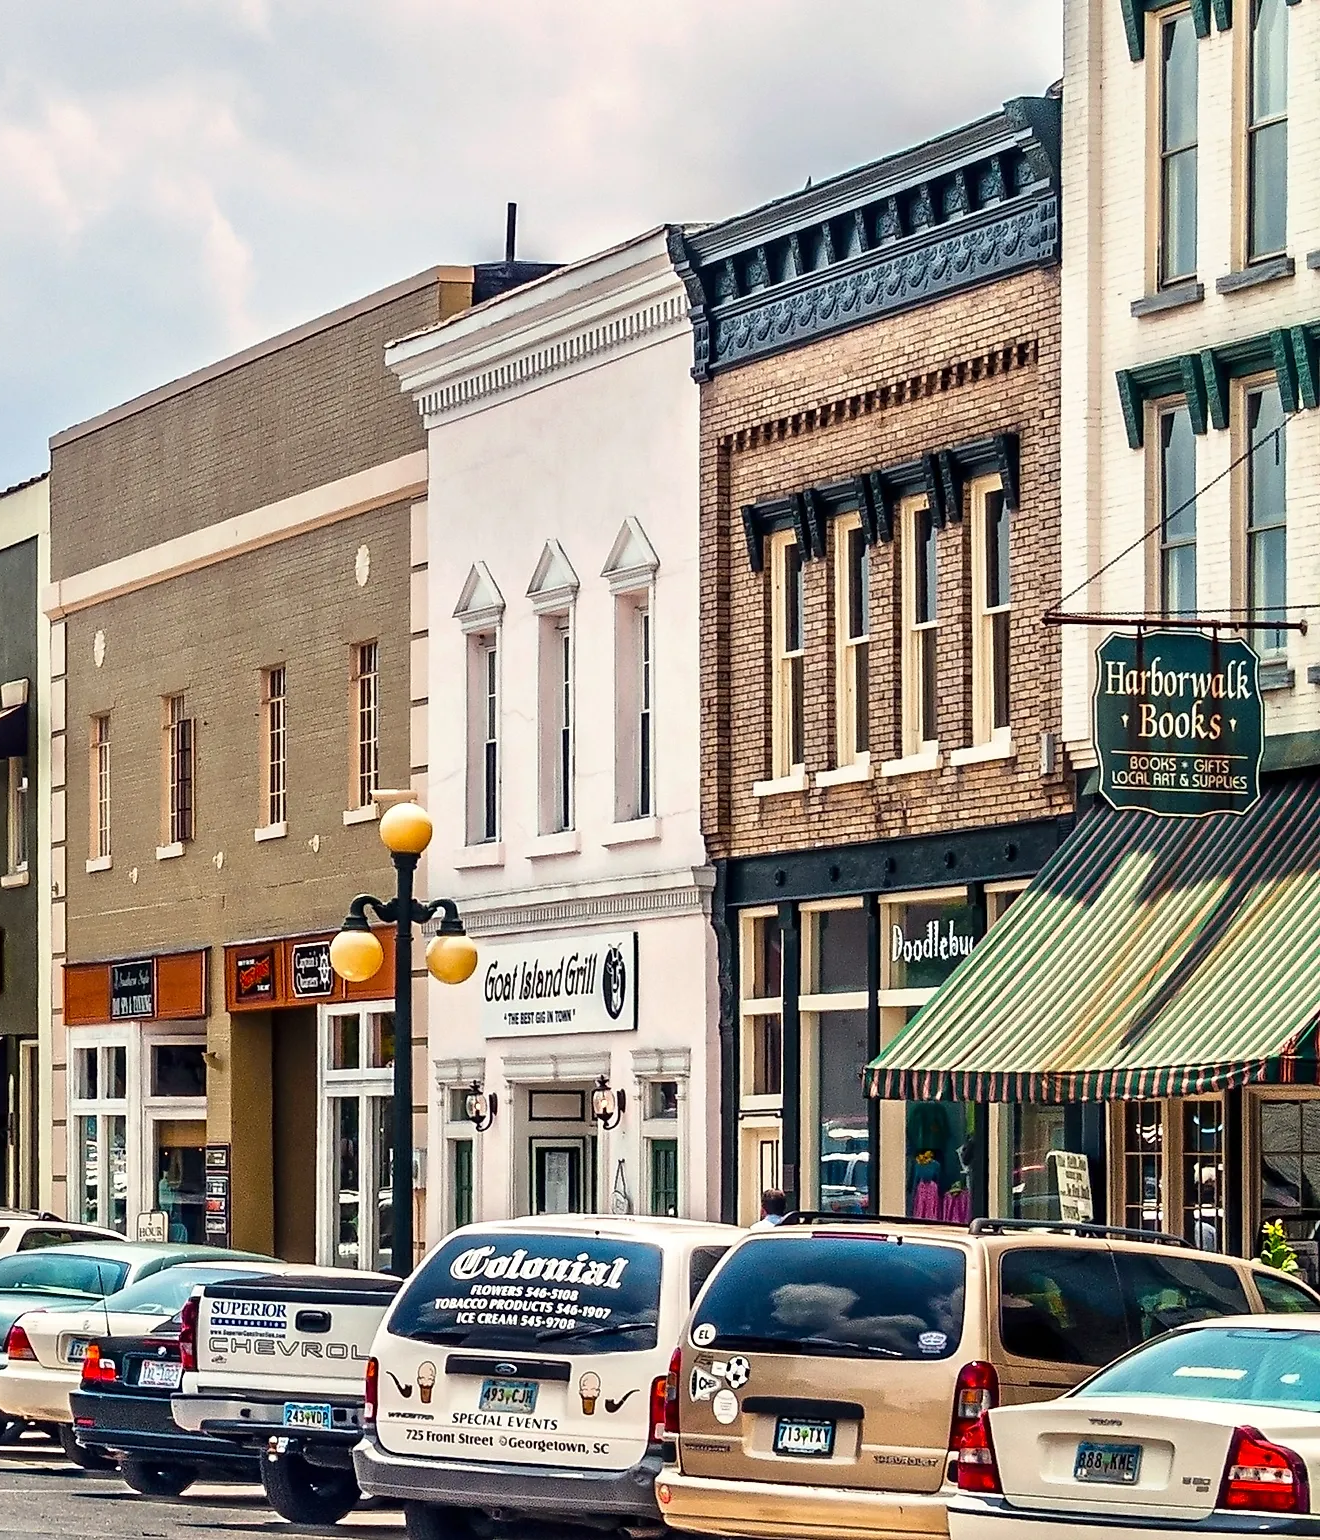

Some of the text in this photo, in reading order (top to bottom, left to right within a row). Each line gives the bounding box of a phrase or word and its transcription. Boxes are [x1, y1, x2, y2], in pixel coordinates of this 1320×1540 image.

[1105, 657, 1253, 699] Harborwalk
[1138, 700, 1222, 740] Books
[1130, 756, 1229, 774] BOOKS GIFTS
[1112, 770, 1248, 790] LOCAL ART & SUPPLIES
[484, 952, 598, 1002] Goat Island Grill
[520, 1010, 534, 1025] BEST
[546, 1009, 554, 1023] IN
[139, 1226, 163, 1238] HOUR
[449, 1245, 630, 1290] Colonial
[470, 1284, 524, 1298] FLOWERS
[211, 1301, 288, 1318] SUPERIOR
[434, 1298, 487, 1310] TOBACCO
[488, 1299, 554, 1314] PRODUCTS
[456, 1312, 476, 1324] ICE
[477, 1312, 518, 1326] CREAM
[698, 1330, 710, 1340] EL
[208, 1336, 371, 1362] CHEVROL
[483, 1388, 533, 1404] 493 CJH
[286, 1409, 305, 1423] 243
[451, 1412, 559, 1431] SPECIAL EVENTS
[406, 1429, 610, 1455] 725 Front Street Georgetown, SC
[780, 1425, 830, 1444] 713 TXY
[873, 1455, 938, 1468] CHEVROLET
